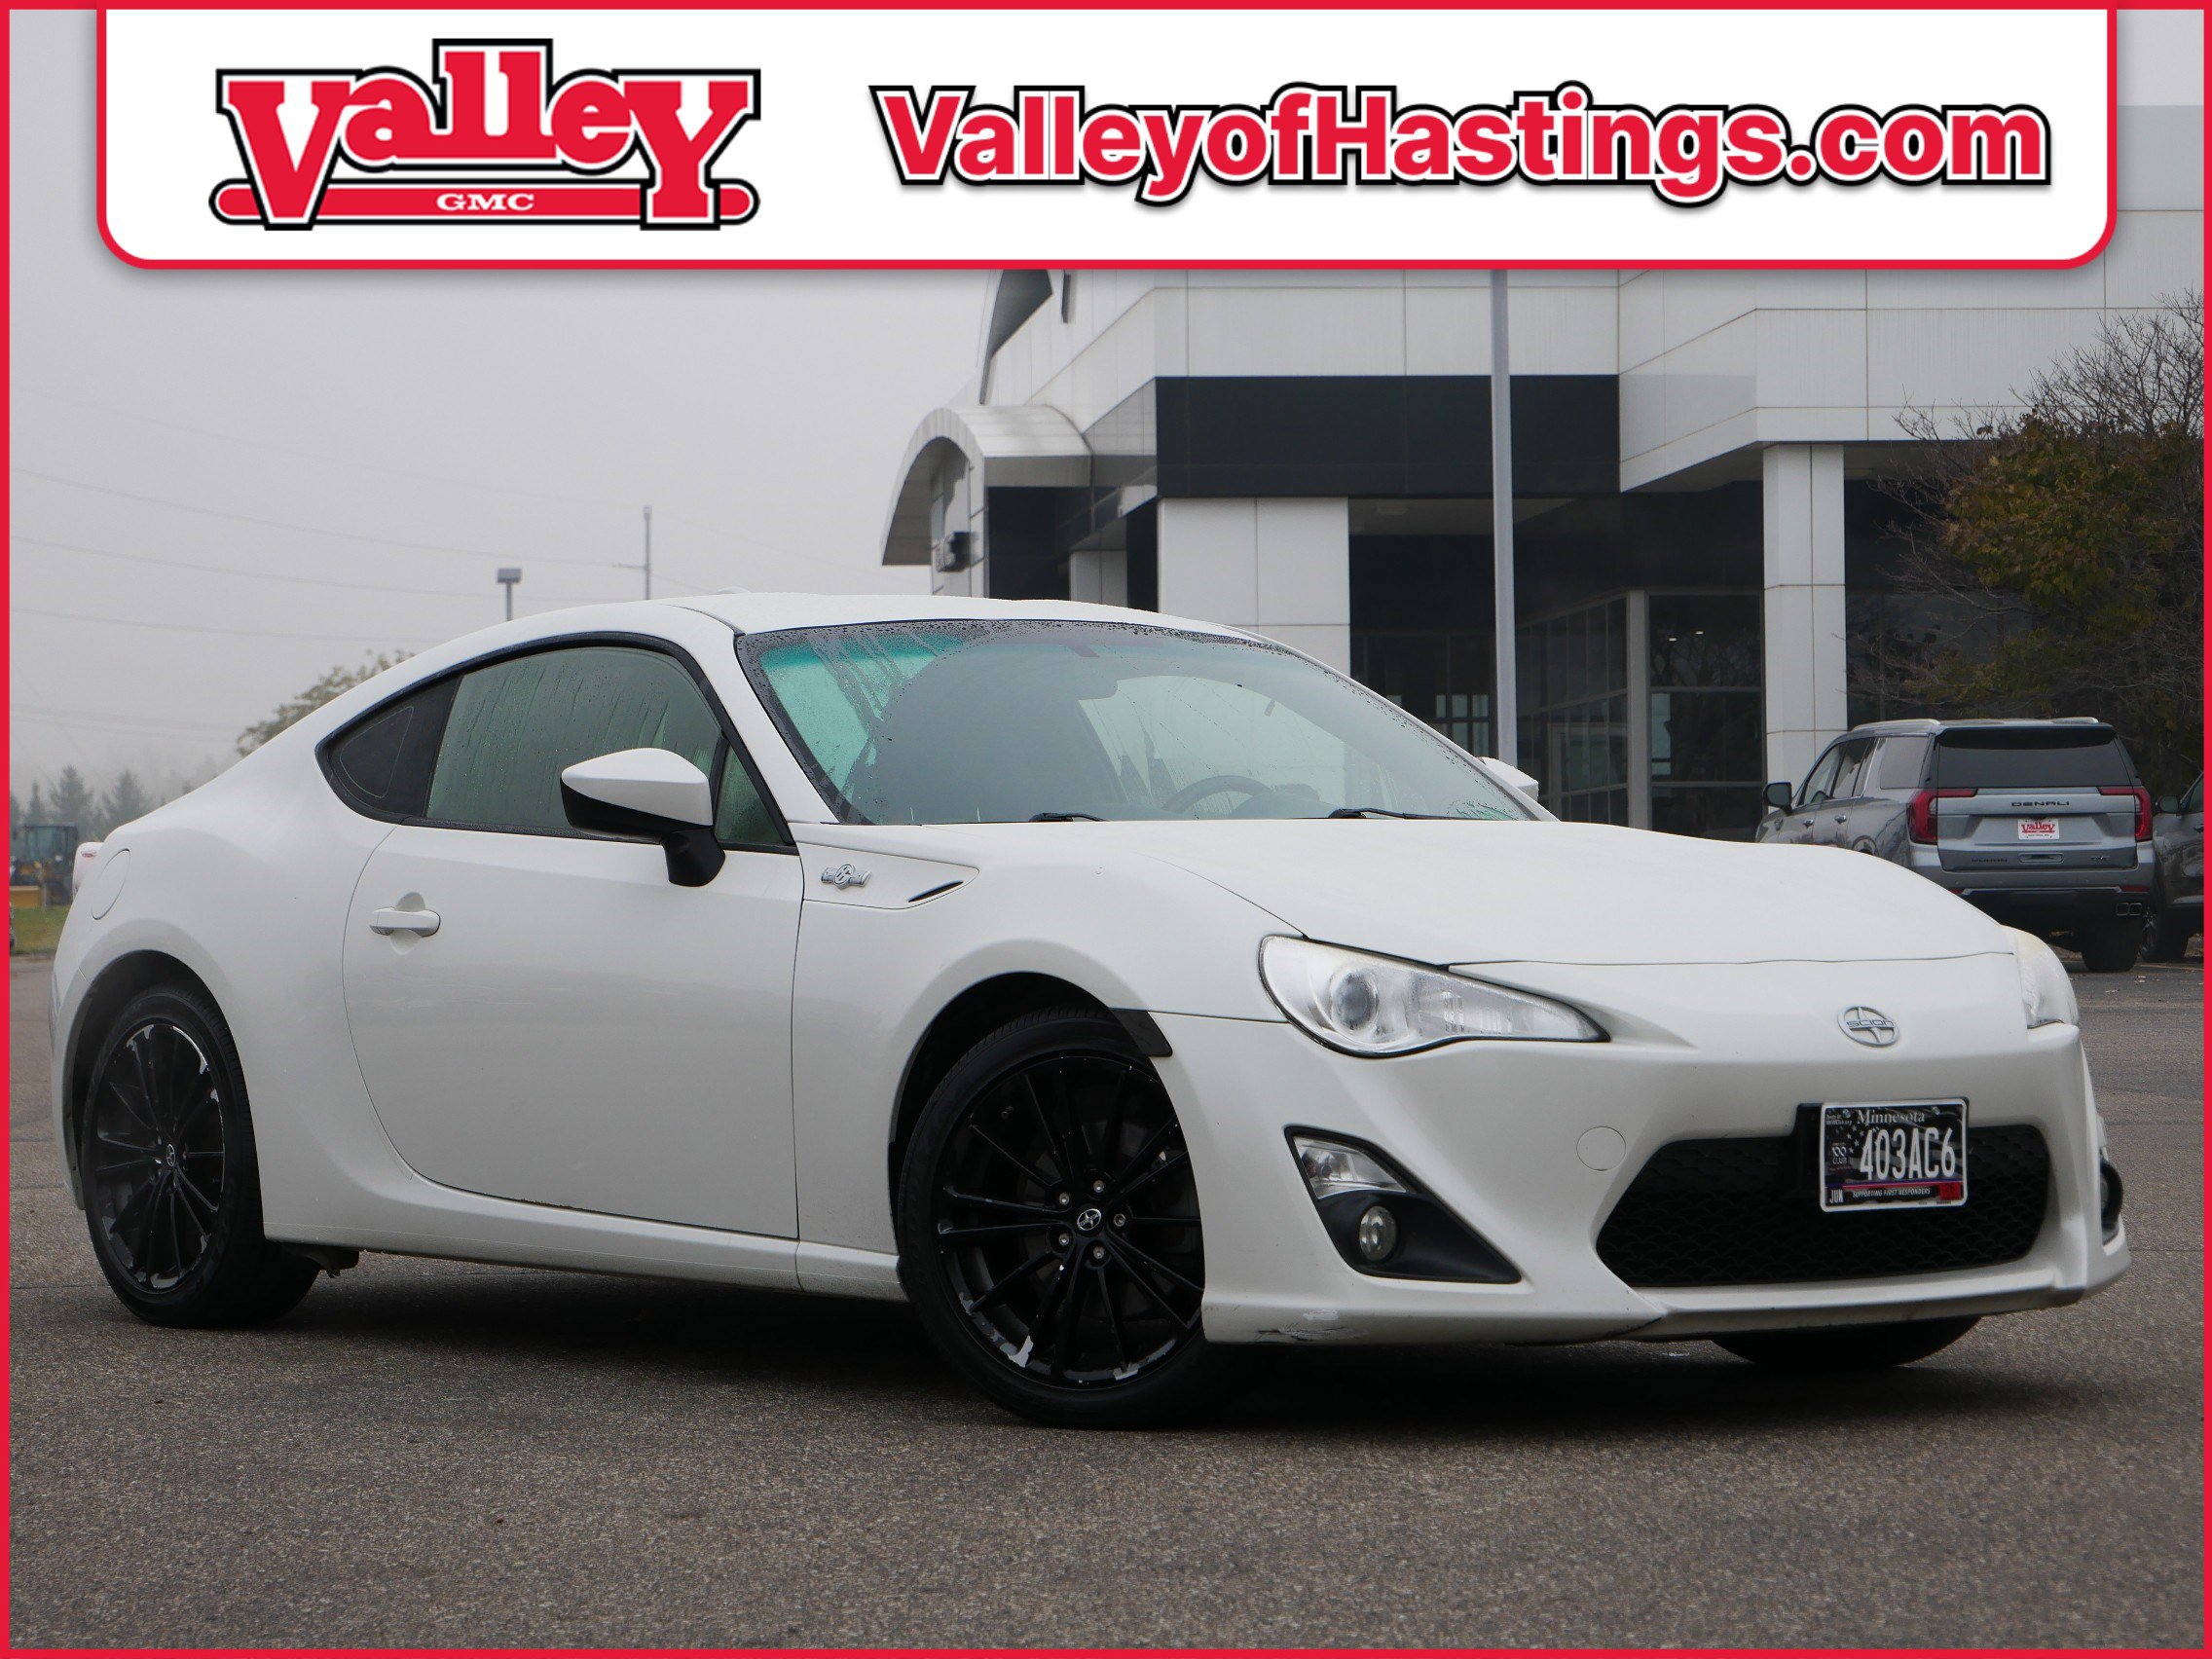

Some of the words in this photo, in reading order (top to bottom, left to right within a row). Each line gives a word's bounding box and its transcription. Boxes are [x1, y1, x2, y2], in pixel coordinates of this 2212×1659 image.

[1857, 1109, 1926, 1125] Minnesota
[1860, 1126, 1957, 1182] 403AC6
[1852, 1189, 1883, 1198] SUPPORTING
[1883, 1188, 1898, 1197] FIRST
[1899, 1187, 1931, 1196] RESPONDERS
